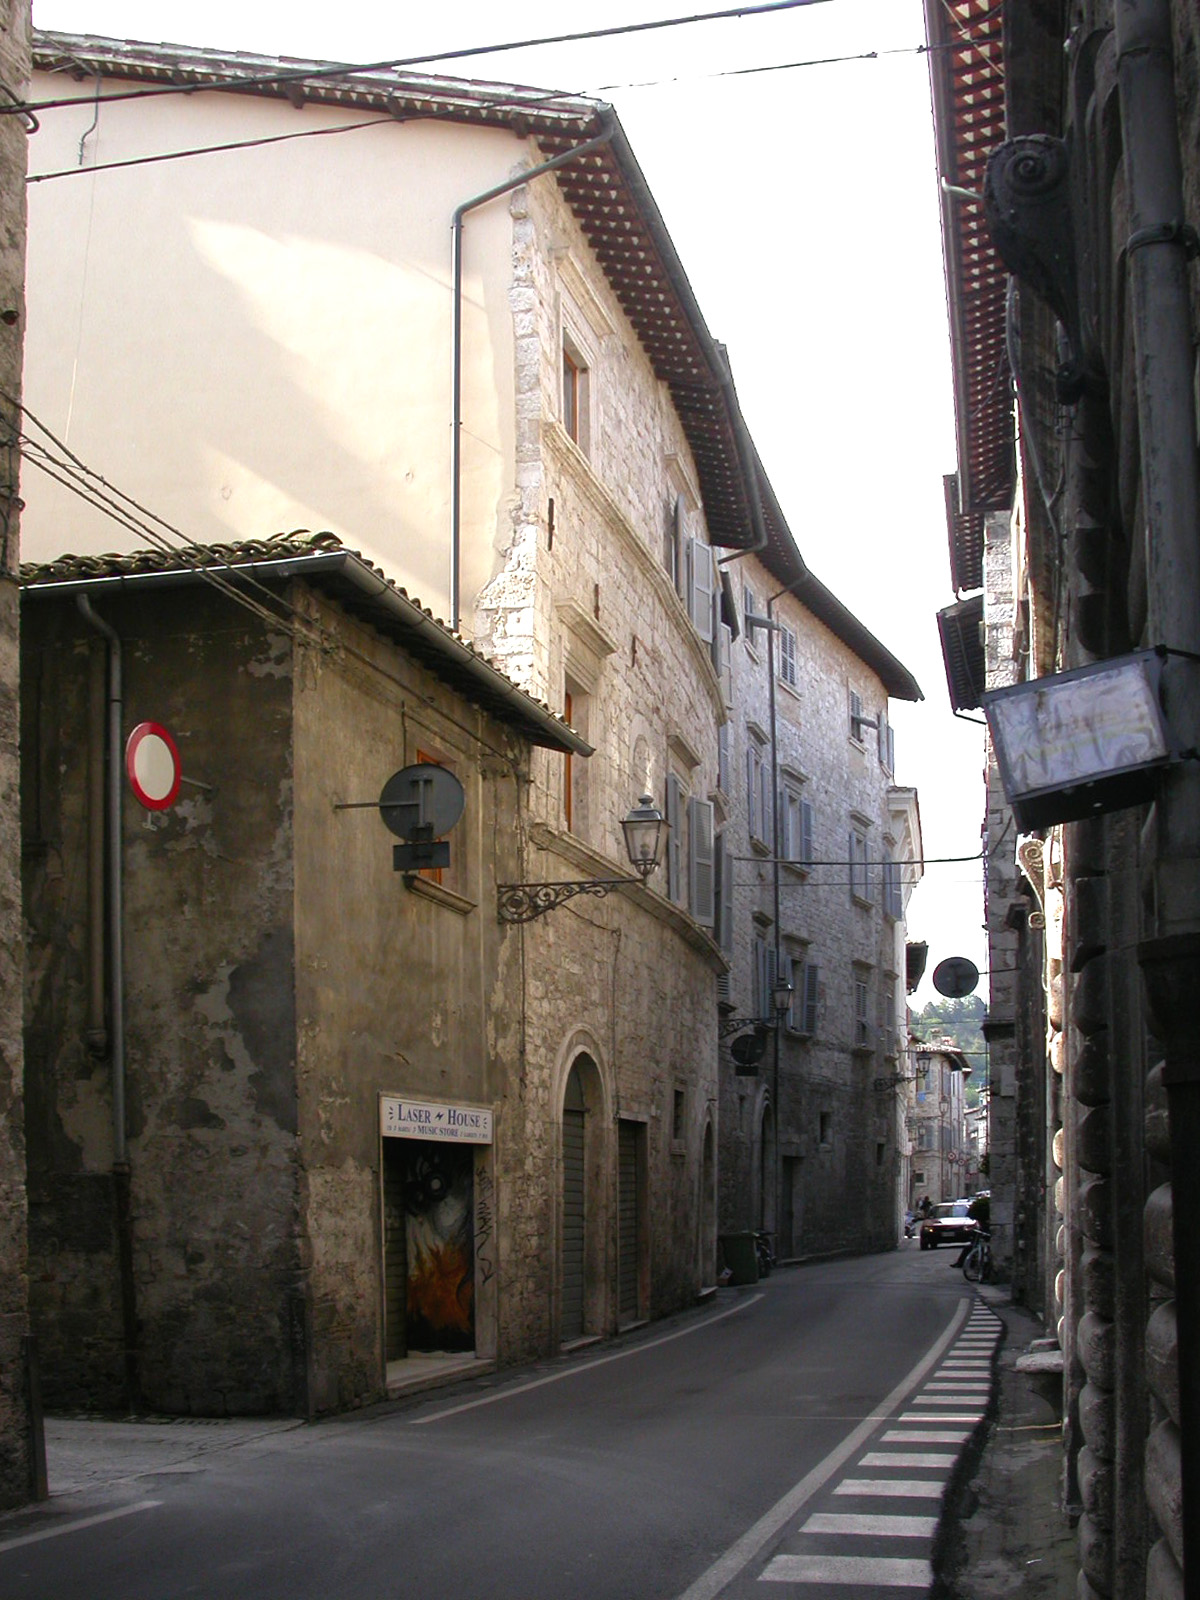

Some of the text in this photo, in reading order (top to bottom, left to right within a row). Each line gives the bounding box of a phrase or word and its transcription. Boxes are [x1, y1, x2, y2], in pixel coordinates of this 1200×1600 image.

[398, 1104, 481, 1128] LASER HOUSE
[417, 1125, 438, 1136] MUSIC
[439, 1127, 459, 1137] STORE
